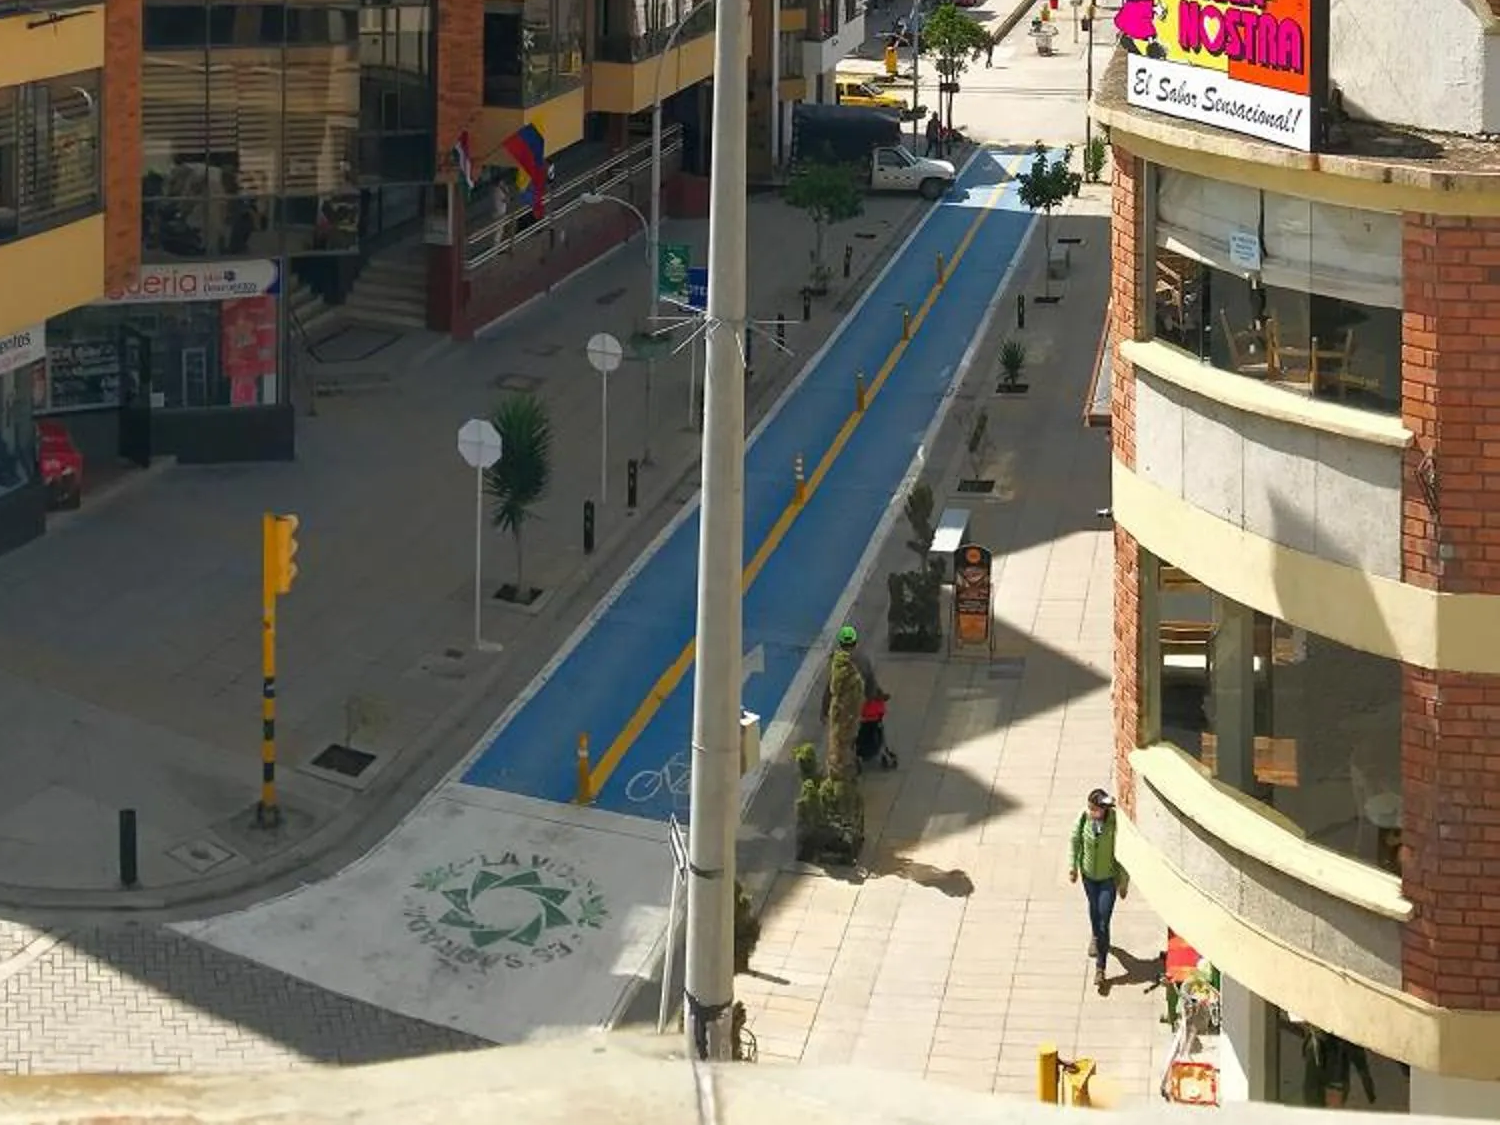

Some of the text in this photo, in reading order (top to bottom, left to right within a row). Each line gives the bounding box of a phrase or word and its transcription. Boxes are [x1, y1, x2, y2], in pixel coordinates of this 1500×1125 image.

[1178, 0, 1305, 75] NOSTRA
[1133, 68, 1303, 133] El Sabor Sensacional!
